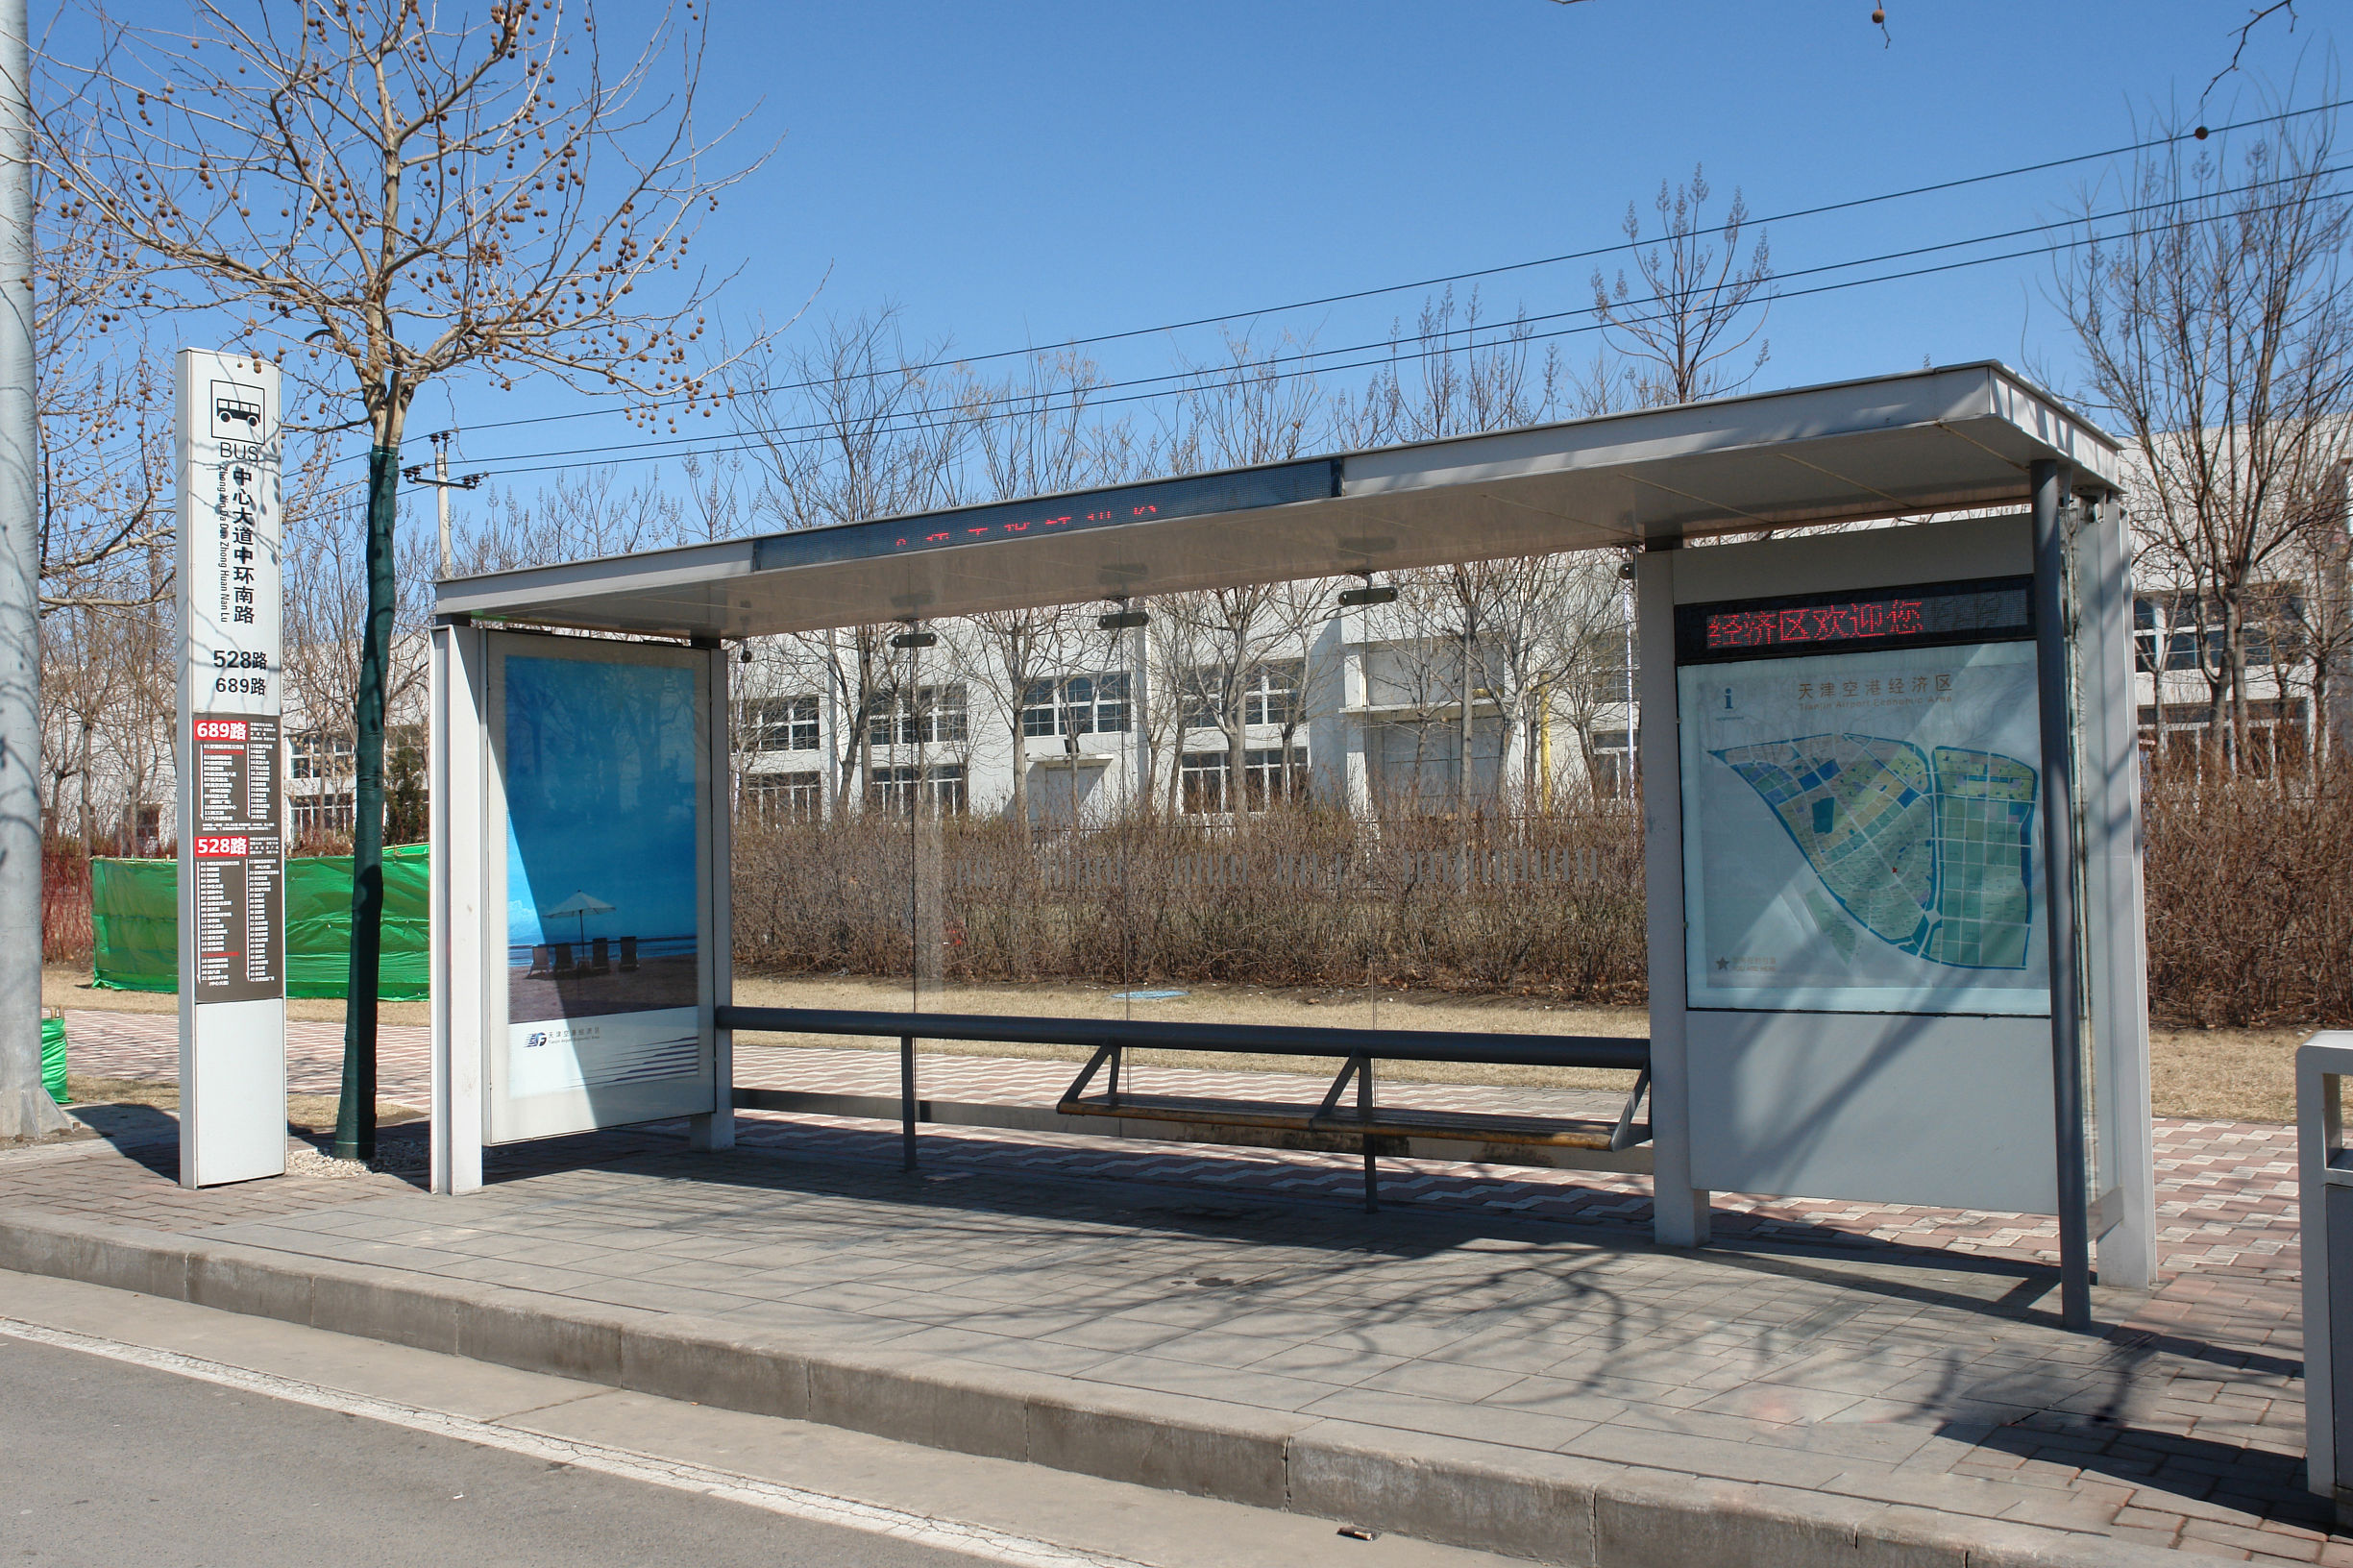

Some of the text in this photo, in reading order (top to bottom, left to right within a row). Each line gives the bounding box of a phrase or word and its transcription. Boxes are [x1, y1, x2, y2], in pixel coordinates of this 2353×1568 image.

[220, 441, 258, 461] BUS
[217, 465, 229, 492] Zhong
[219, 493, 229, 508] Xin
[219, 510, 230, 522] Da
[218, 541, 230, 568] Zhong
[233, 467, 255, 625] 中心大道中环南路
[220, 570, 230, 592] Huan
[220, 593, 230, 610] Nan
[220, 612, 230, 623] Lu
[1708, 600, 1923, 647] 经济区欢迎您
[213, 649, 268, 671] 528路
[215, 677, 267, 697] 689路
[1798, 674, 1953, 700] 天津空港经济区
[1798, 695, 1953, 713] Tianjin Airport Economic Area
[197, 723, 247, 740] 689路
[197, 837, 247, 855] 528路
